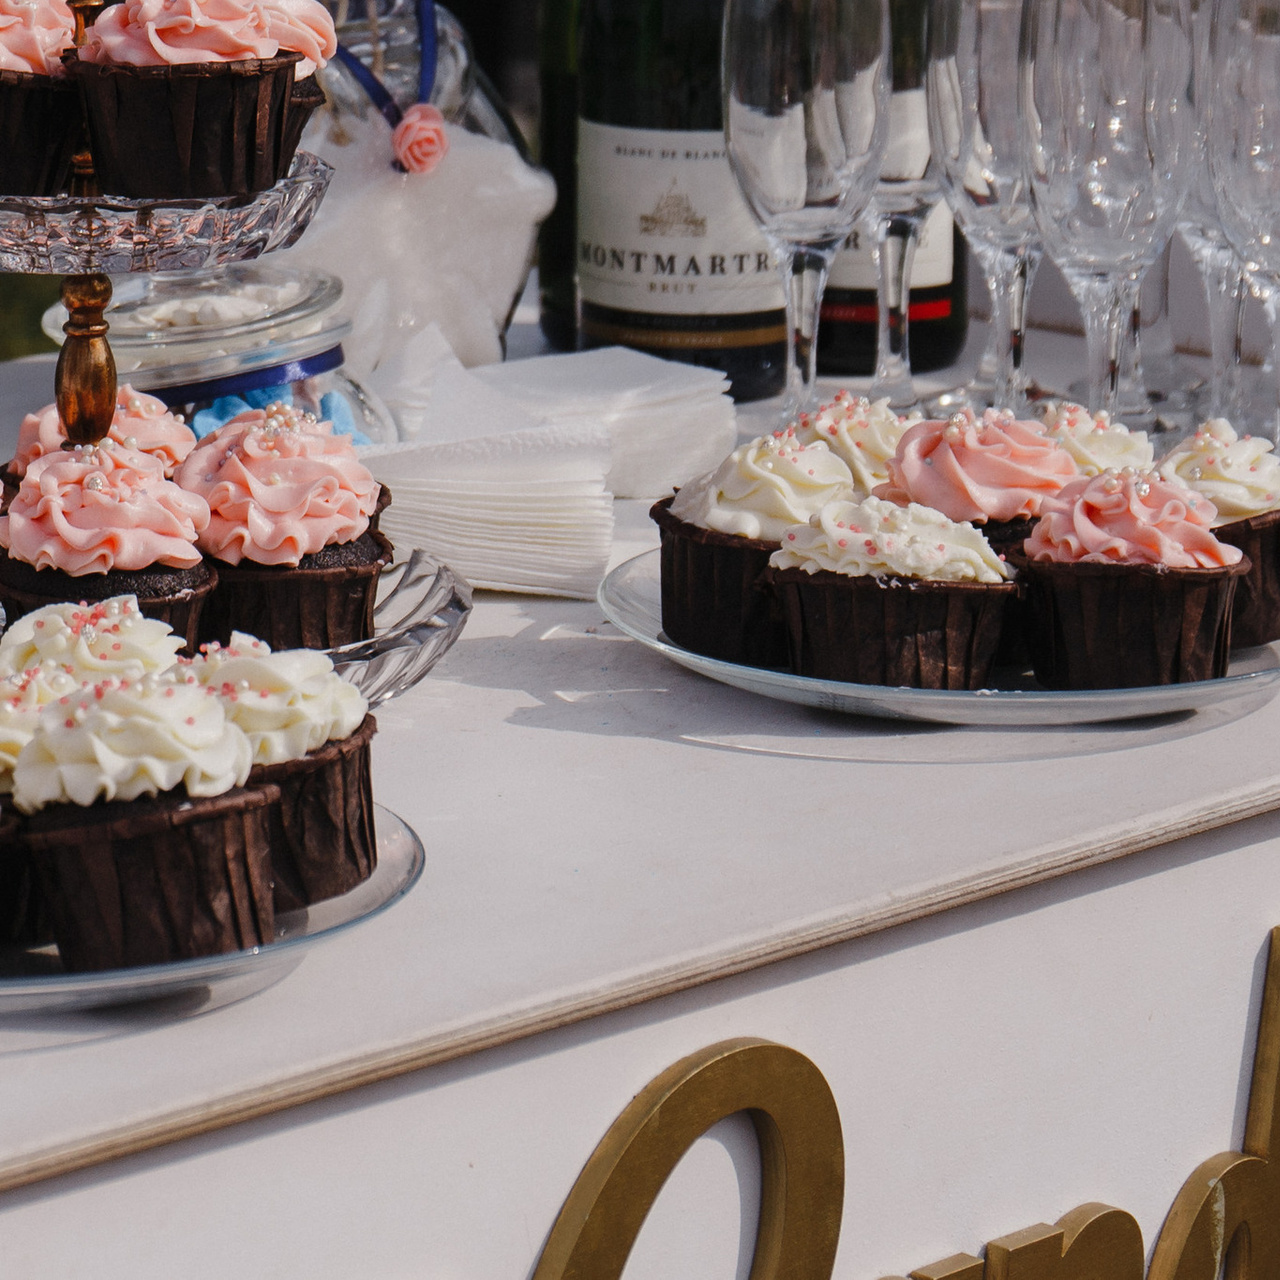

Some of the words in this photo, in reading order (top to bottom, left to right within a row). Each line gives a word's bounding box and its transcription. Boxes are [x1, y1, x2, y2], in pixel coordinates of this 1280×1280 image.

[615, 146, 654, 158] BLANC
[660, 150, 678, 160] DE
[581, 241, 778, 276] MONTMARTR
[648, 281, 698, 294] BRUT
